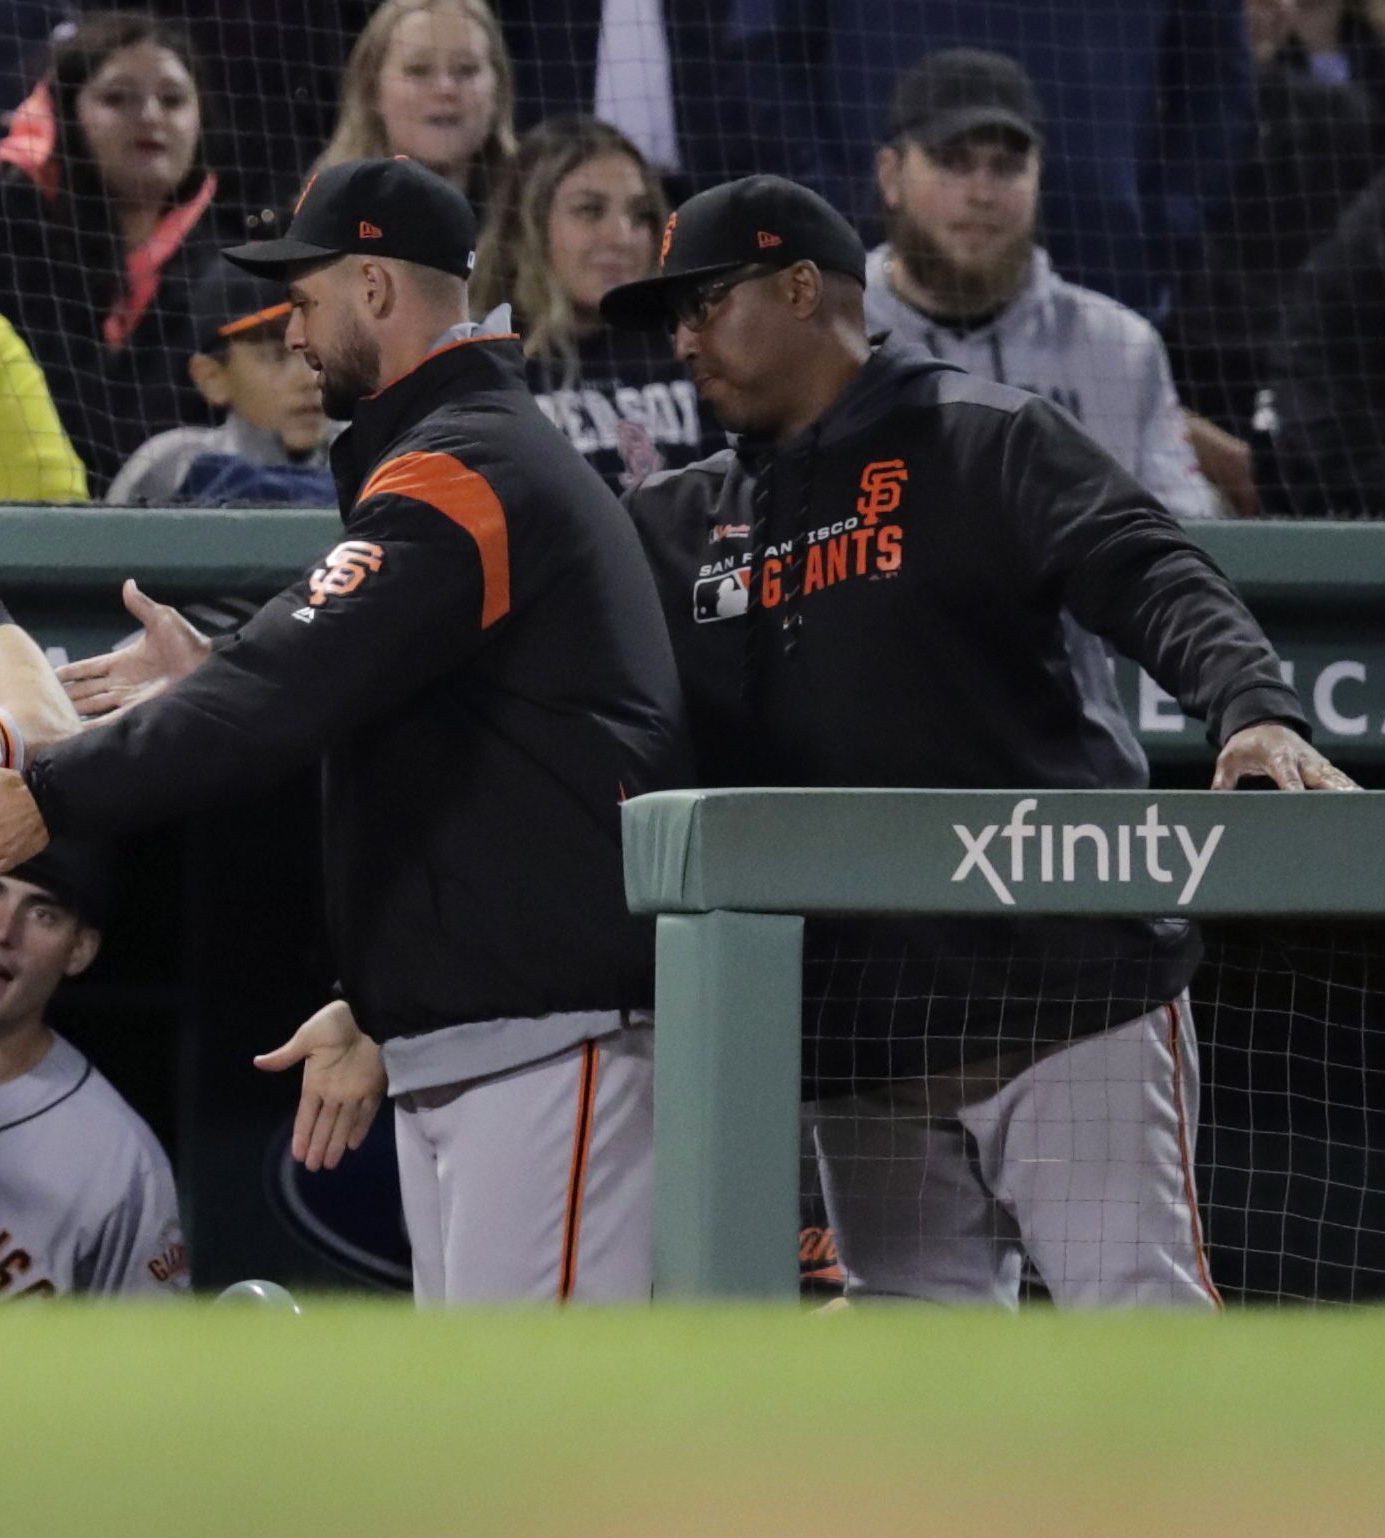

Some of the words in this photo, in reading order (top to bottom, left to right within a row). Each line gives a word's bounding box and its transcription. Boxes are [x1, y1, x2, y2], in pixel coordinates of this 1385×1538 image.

[858, 459, 908, 526] SF
[309, 541, 384, 605] SF
[699, 554, 735, 577] SAN
[742, 516, 859, 564] FANISCO
[951, 798, 1226, 905] xfinity
